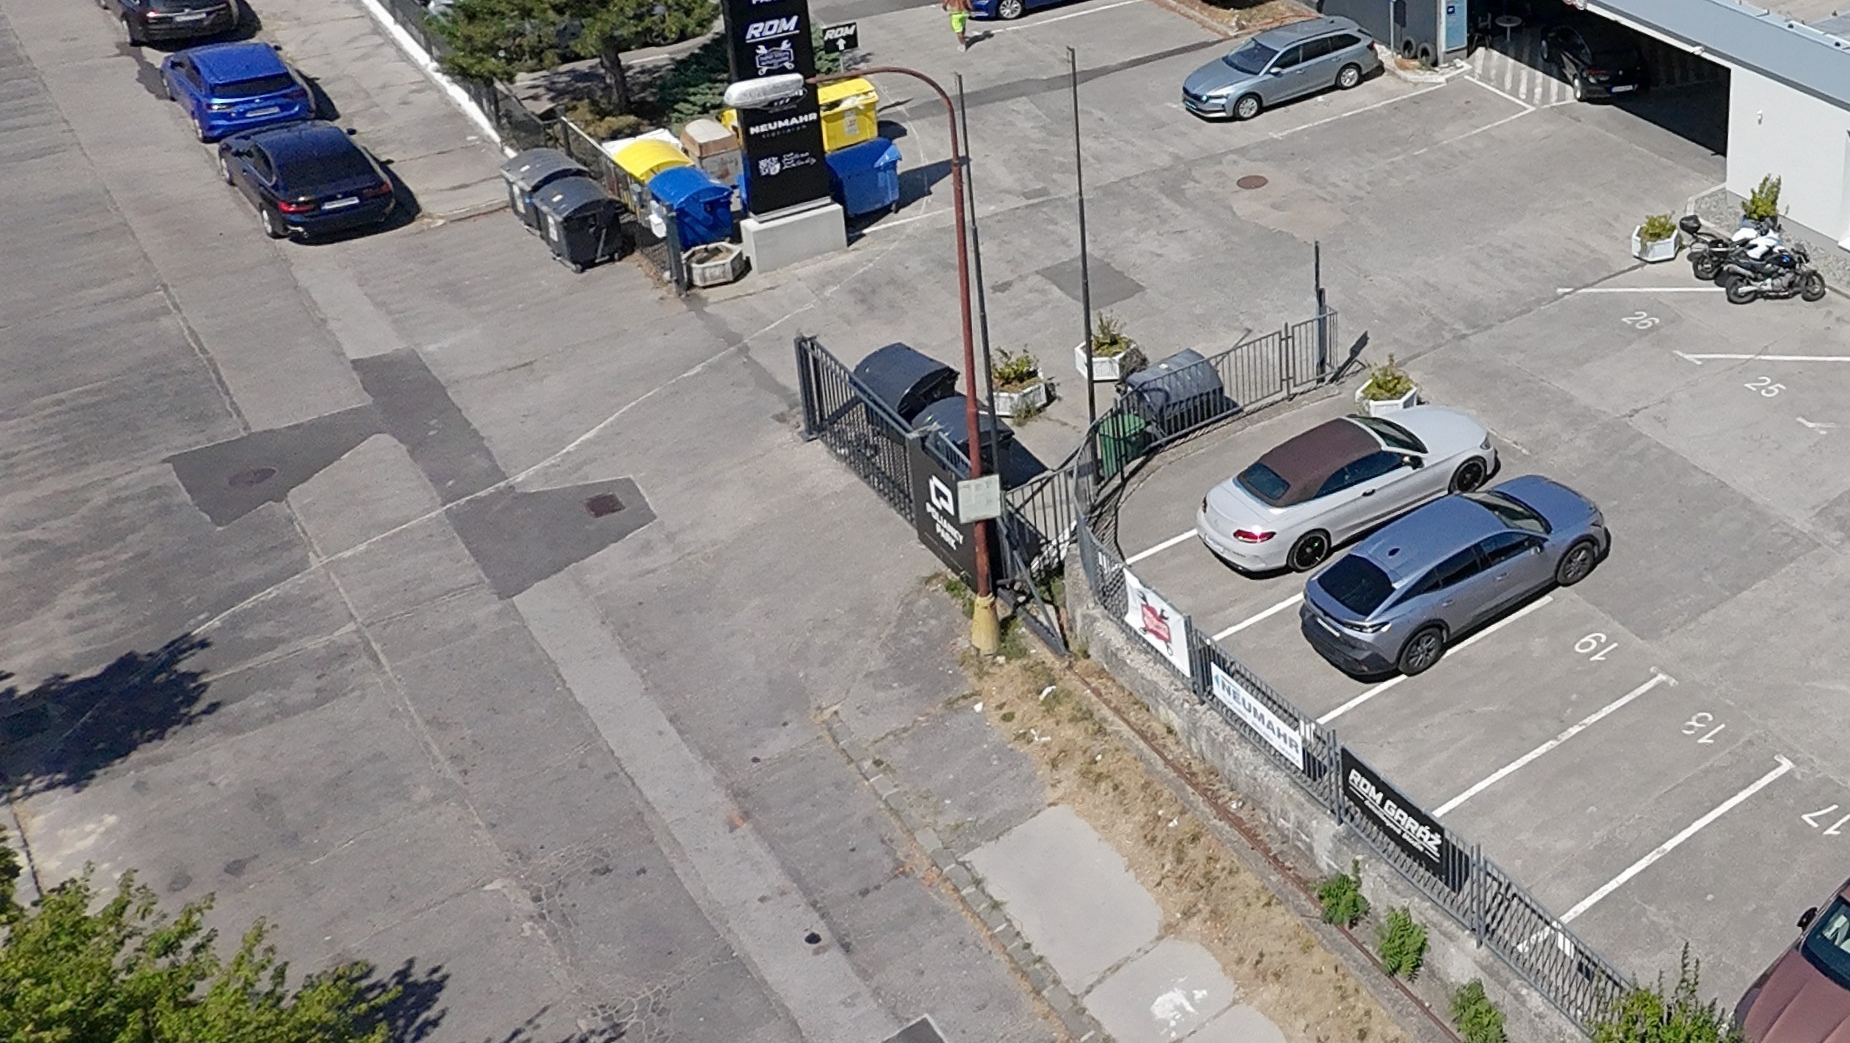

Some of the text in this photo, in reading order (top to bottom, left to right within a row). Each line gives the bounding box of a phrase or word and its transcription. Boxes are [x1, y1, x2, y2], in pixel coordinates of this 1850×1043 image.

[749, 112, 818, 135] NEUMAHR
[1621, 311, 1660, 329] 26
[1744, 376, 1787, 397] 25
[1574, 632, 1619, 662] 19
[1221, 679, 1300, 755] NEUMAHR
[1383, 799, 1442, 853] GARÁŽ
